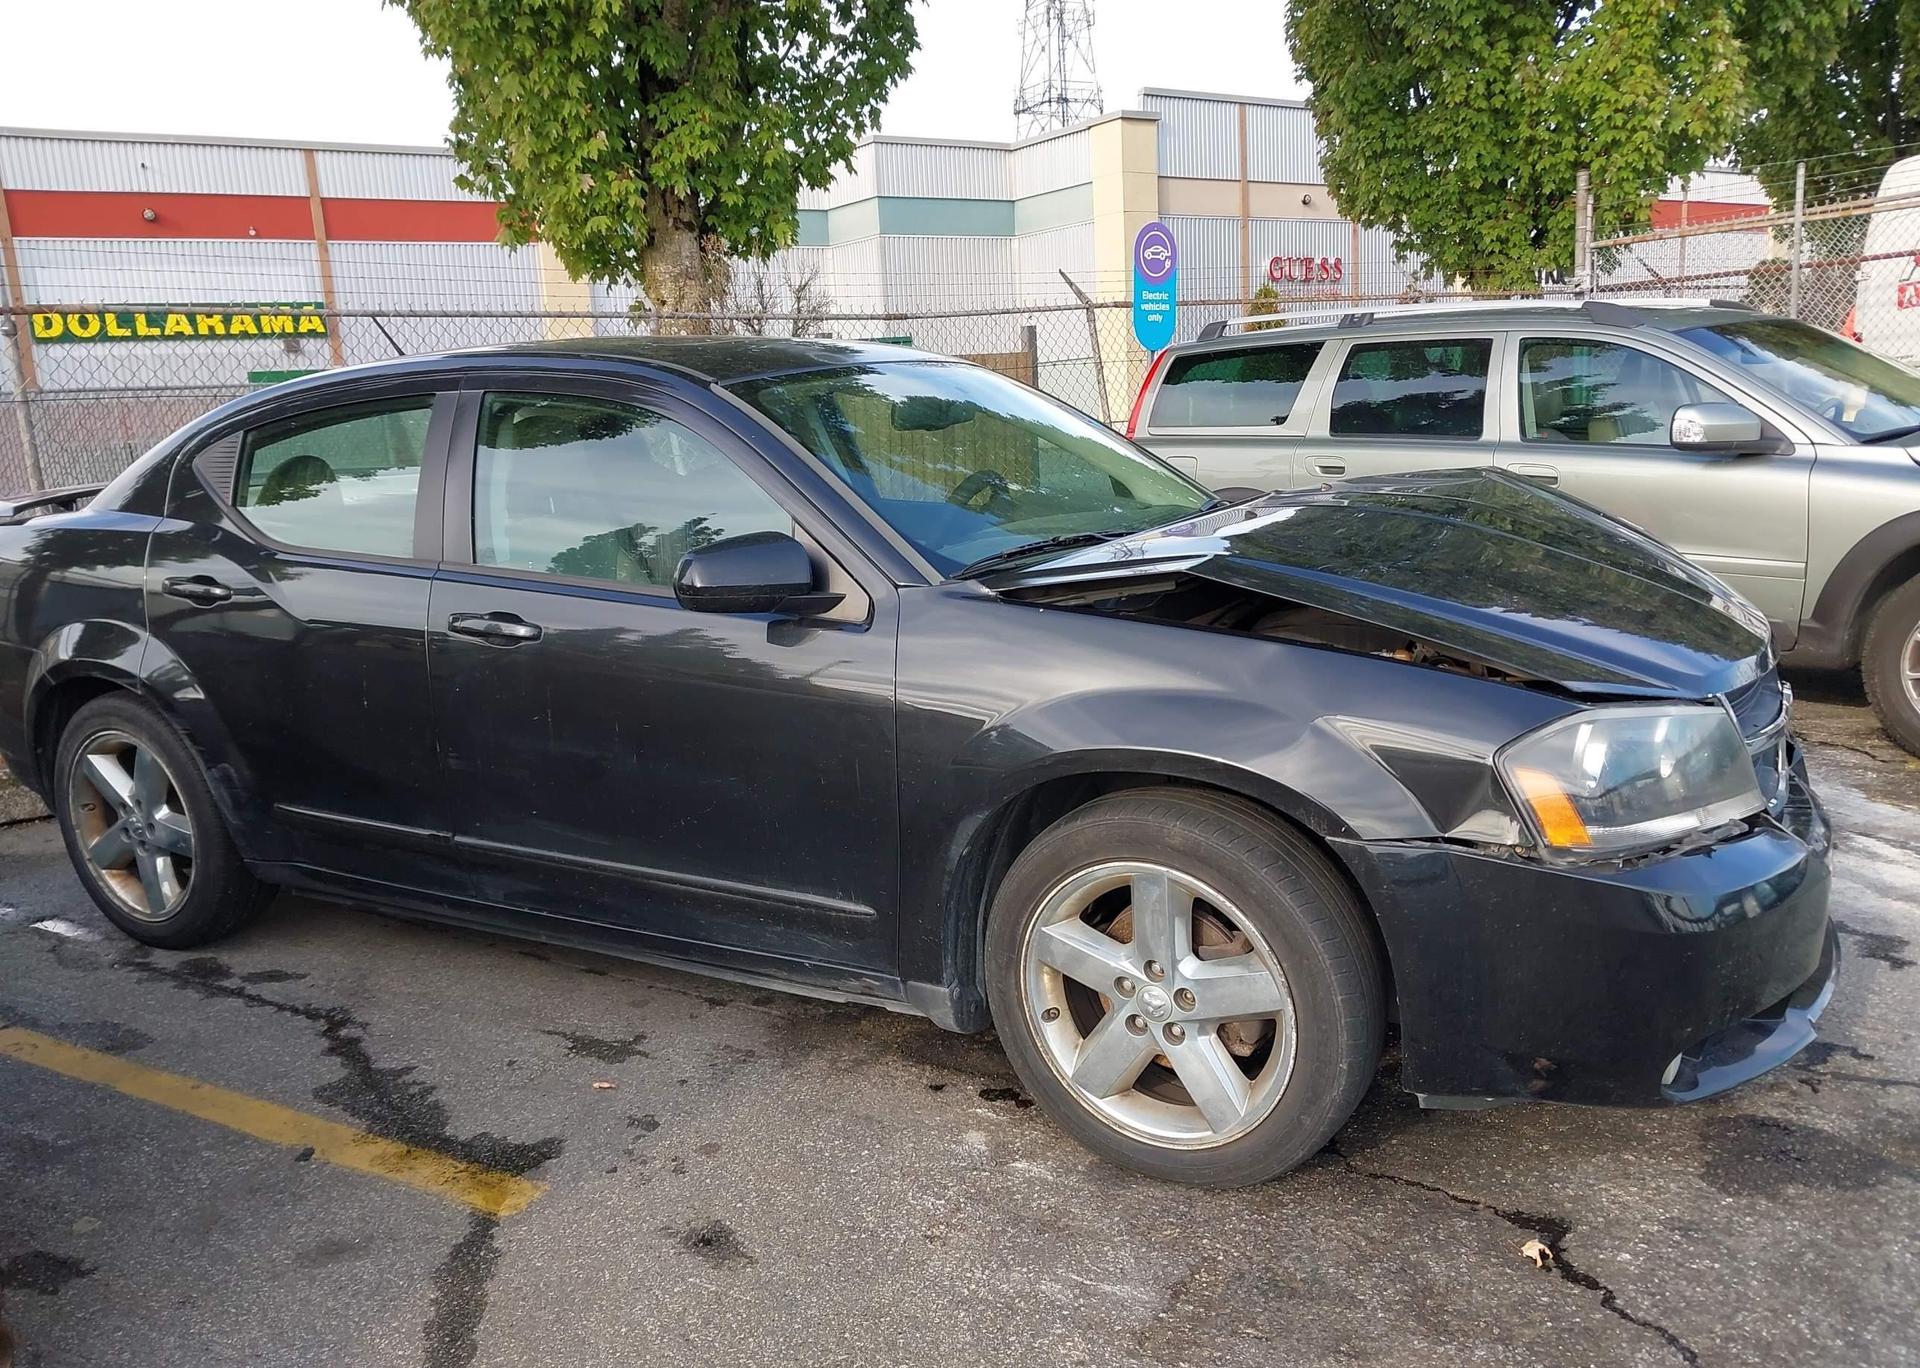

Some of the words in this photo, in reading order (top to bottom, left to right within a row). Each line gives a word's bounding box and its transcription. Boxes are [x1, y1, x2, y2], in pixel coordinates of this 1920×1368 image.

[1268, 256, 1343, 281] GUESS
[1142, 290, 1169, 300] Electric
[1140, 302, 1170, 311] vehicles
[32, 306, 327, 339] DOLLARAMA
[1147, 313, 1164, 323] only
